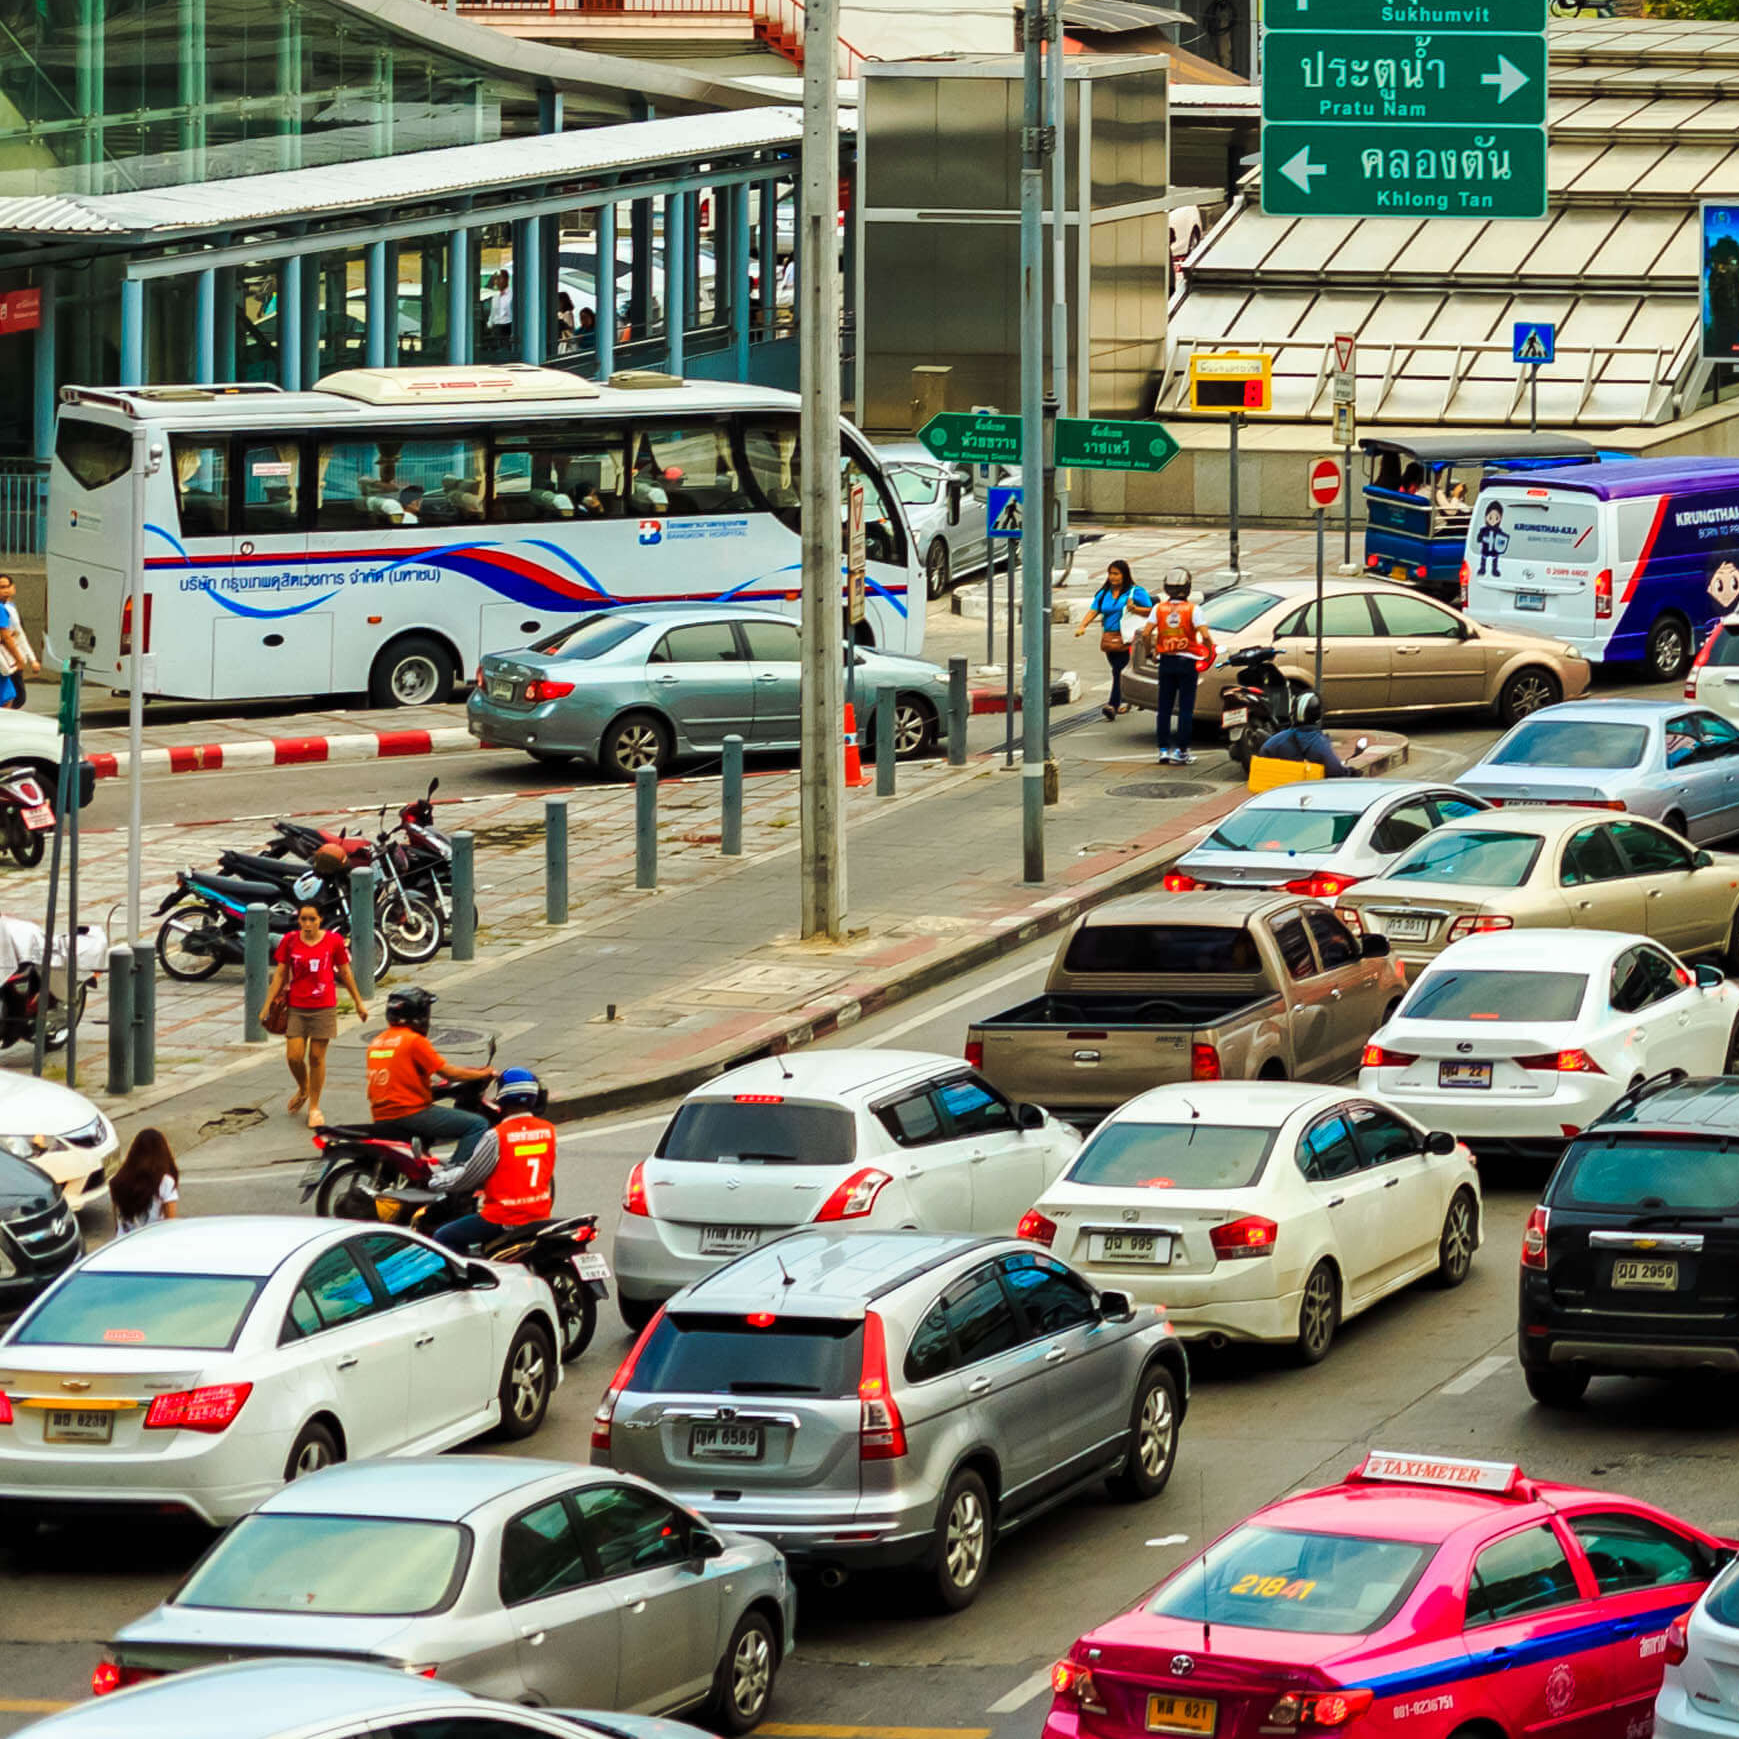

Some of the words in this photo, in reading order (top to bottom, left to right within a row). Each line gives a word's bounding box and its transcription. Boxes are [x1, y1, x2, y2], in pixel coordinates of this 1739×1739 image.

[1382, 6, 1490, 22] Sukhumvit
[1301, 36, 1446, 101] ประตูน้ำ
[1320, 101, 1375, 117] Pratu
[1384, 101, 1427, 117] Nam
[1361, 135, 1513, 180] คลองตัน
[1377, 190, 1449, 211] Khlong
[1458, 190, 1493, 207] Tan
[526, 1158, 540, 1188] 7
[1130, 1237, 1153, 1251] 995
[1383, 1458, 1482, 1483] TAXI-METER
[1230, 1574, 1317, 1600] 21841
